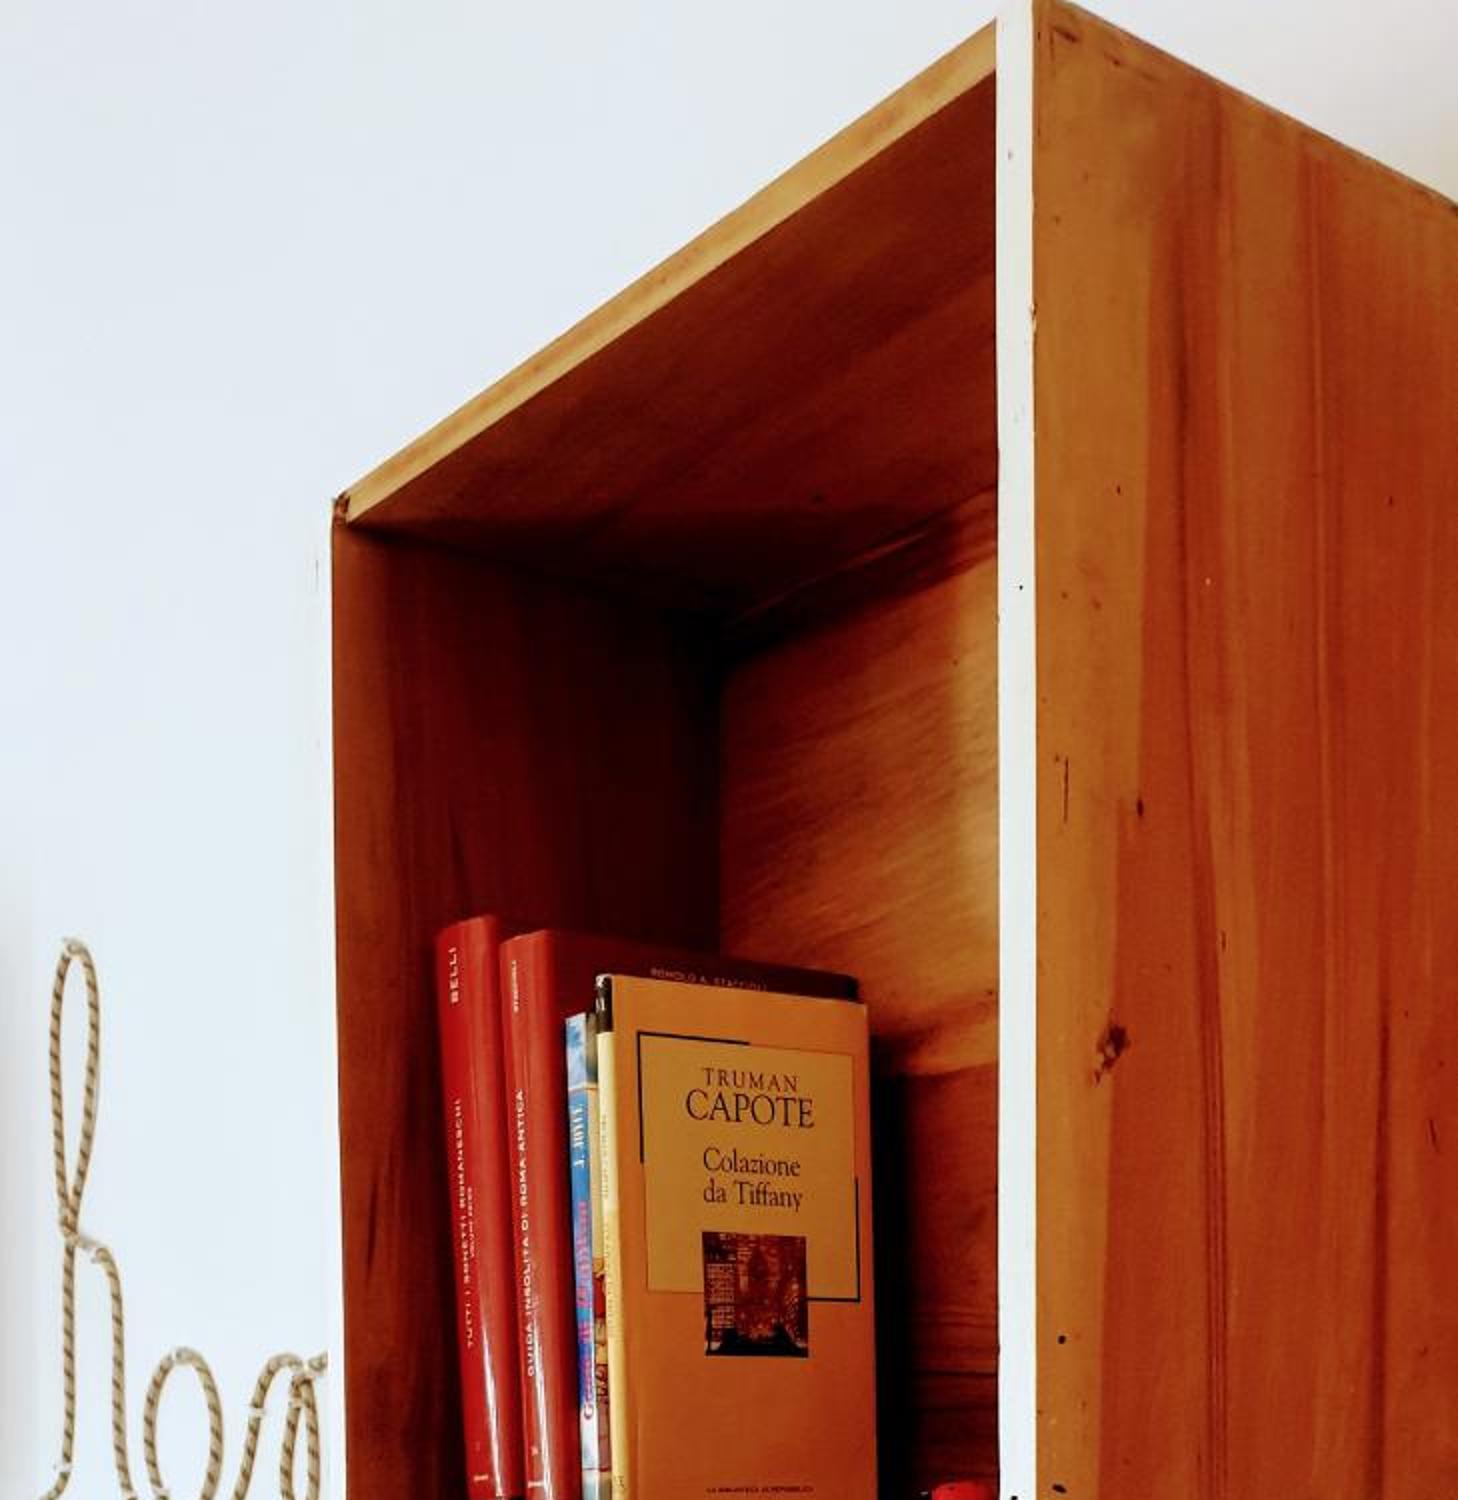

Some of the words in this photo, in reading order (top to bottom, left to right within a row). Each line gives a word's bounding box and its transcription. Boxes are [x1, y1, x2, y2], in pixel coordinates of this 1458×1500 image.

[448, 946, 459, 1004] BELLI
[704, 1067, 798, 1093] TRUMAN
[515, 1088, 526, 1151] ANTICA
[685, 1088, 815, 1128] CAPOTE
[454, 1098, 466, 1209] ROMANESCHI
[703, 1147, 801, 1177] Colazione
[519, 1158, 528, 1207] ROMA
[703, 1177, 727, 1203] da
[733, 1180, 803, 1213] Tiffany
[521, 1213, 529, 1231] DI
[461, 1215, 470, 1284] SONETTI
[522, 1237, 533, 1316] INSOLITA
[465, 1302, 473, 1348] TUTTI
[526, 1322, 535, 1377] GUIDA
